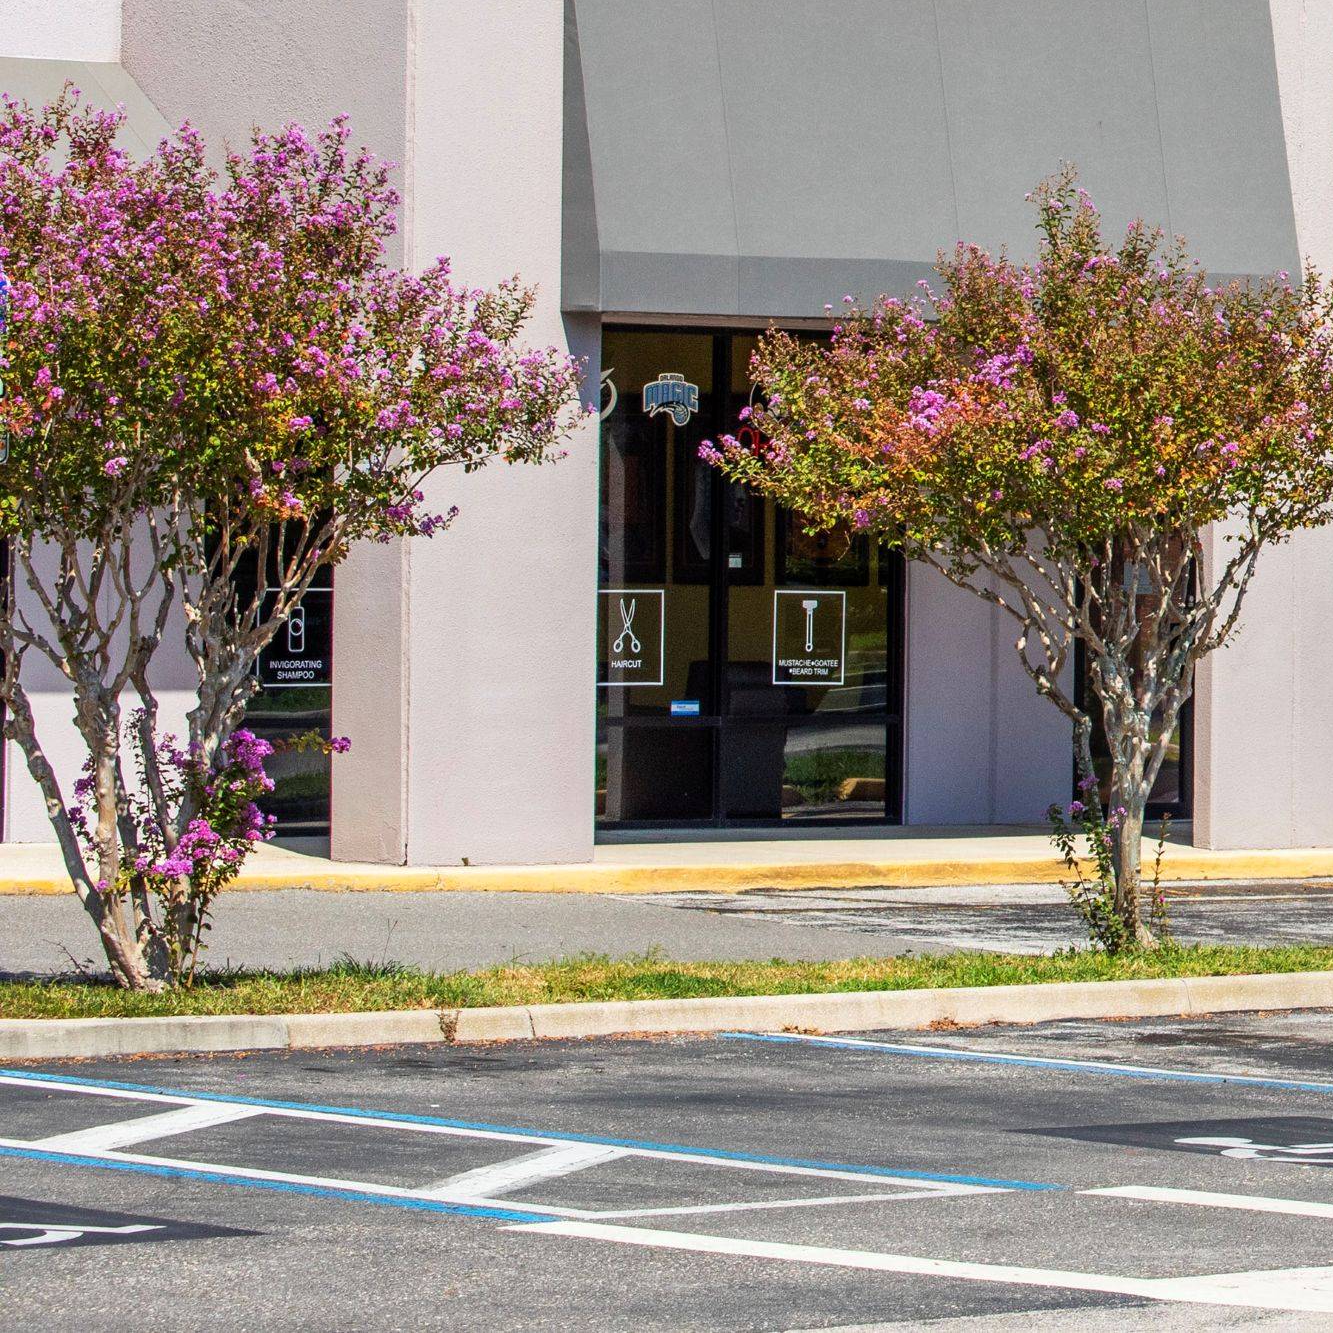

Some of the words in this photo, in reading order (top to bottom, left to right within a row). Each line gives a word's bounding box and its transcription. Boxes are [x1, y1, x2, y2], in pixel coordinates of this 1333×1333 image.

[643, 381, 698, 413] MAGIC
[269, 660, 323, 669] INVIGORATING
[611, 659, 642, 668] HAIRCUT
[276, 670, 315, 680] SHAMPOO
